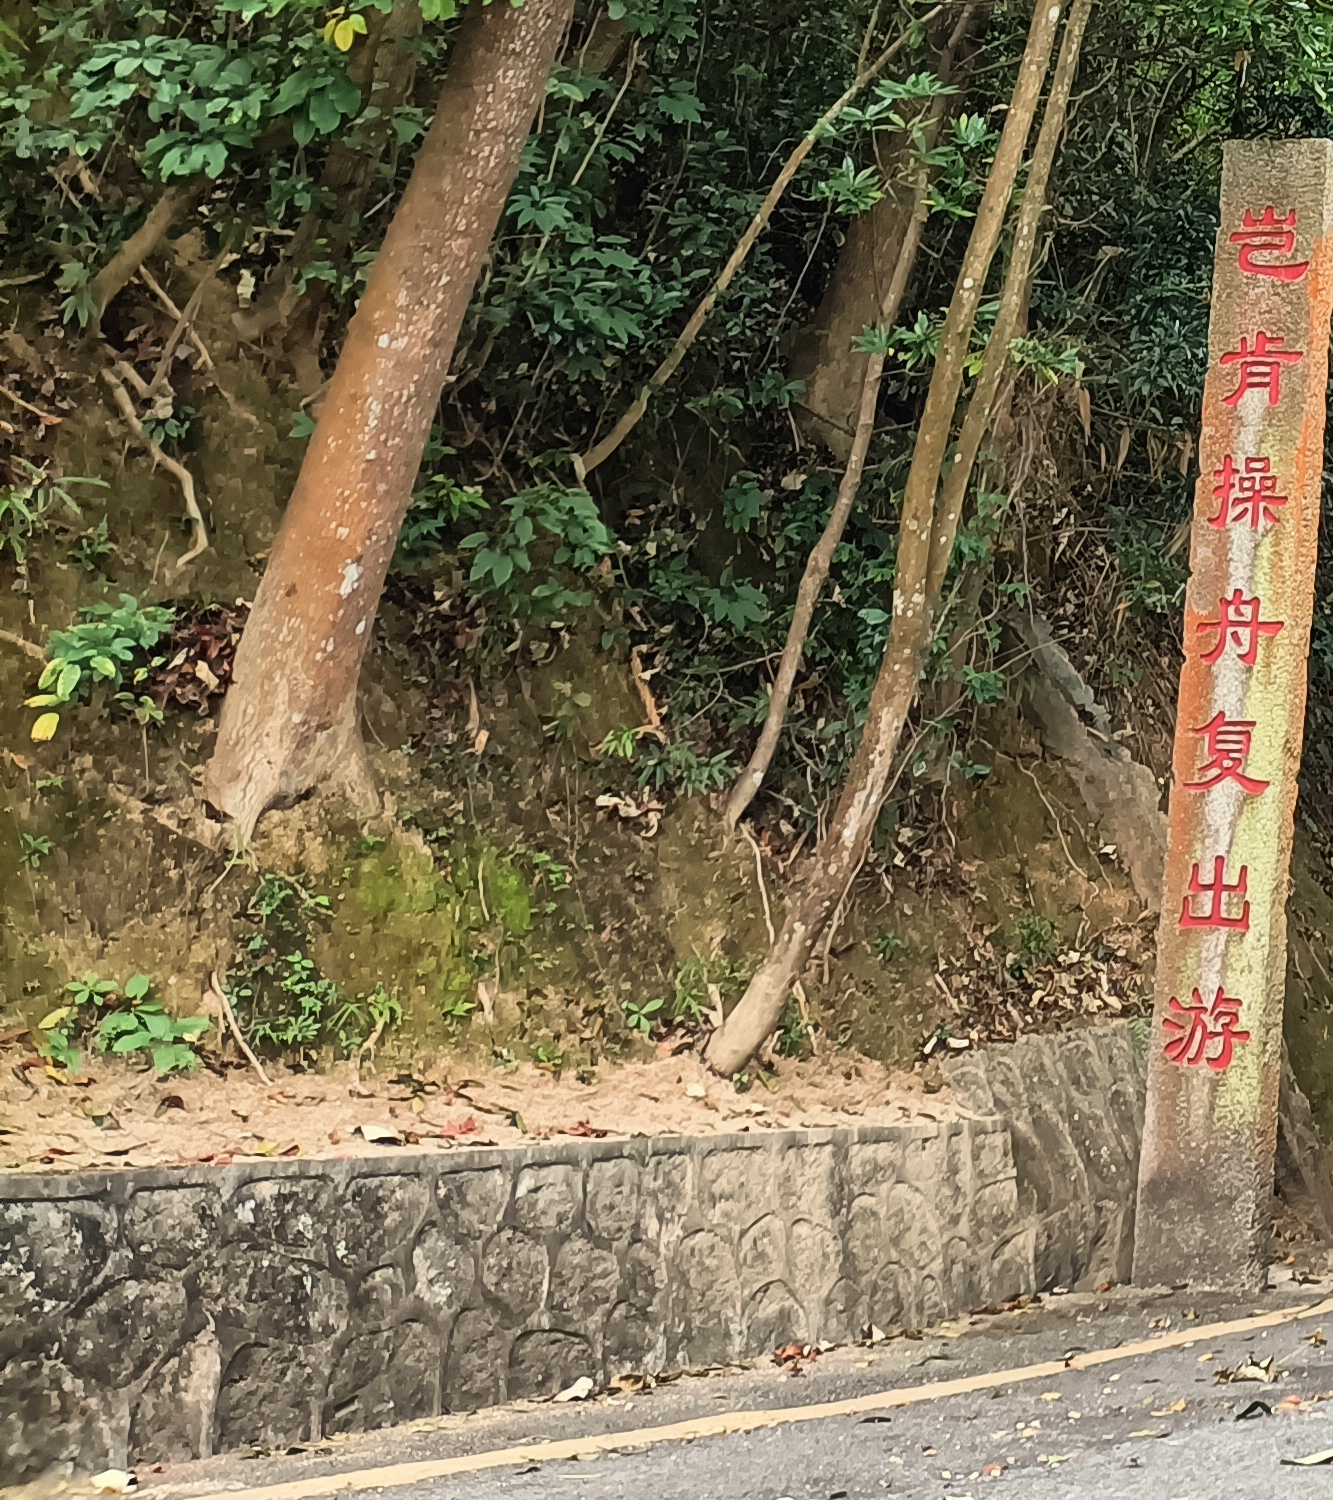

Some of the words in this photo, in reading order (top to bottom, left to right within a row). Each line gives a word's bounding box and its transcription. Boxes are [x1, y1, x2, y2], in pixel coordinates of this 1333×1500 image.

[1162, 205, 1309, 1070] 岂肯操舟复出游
